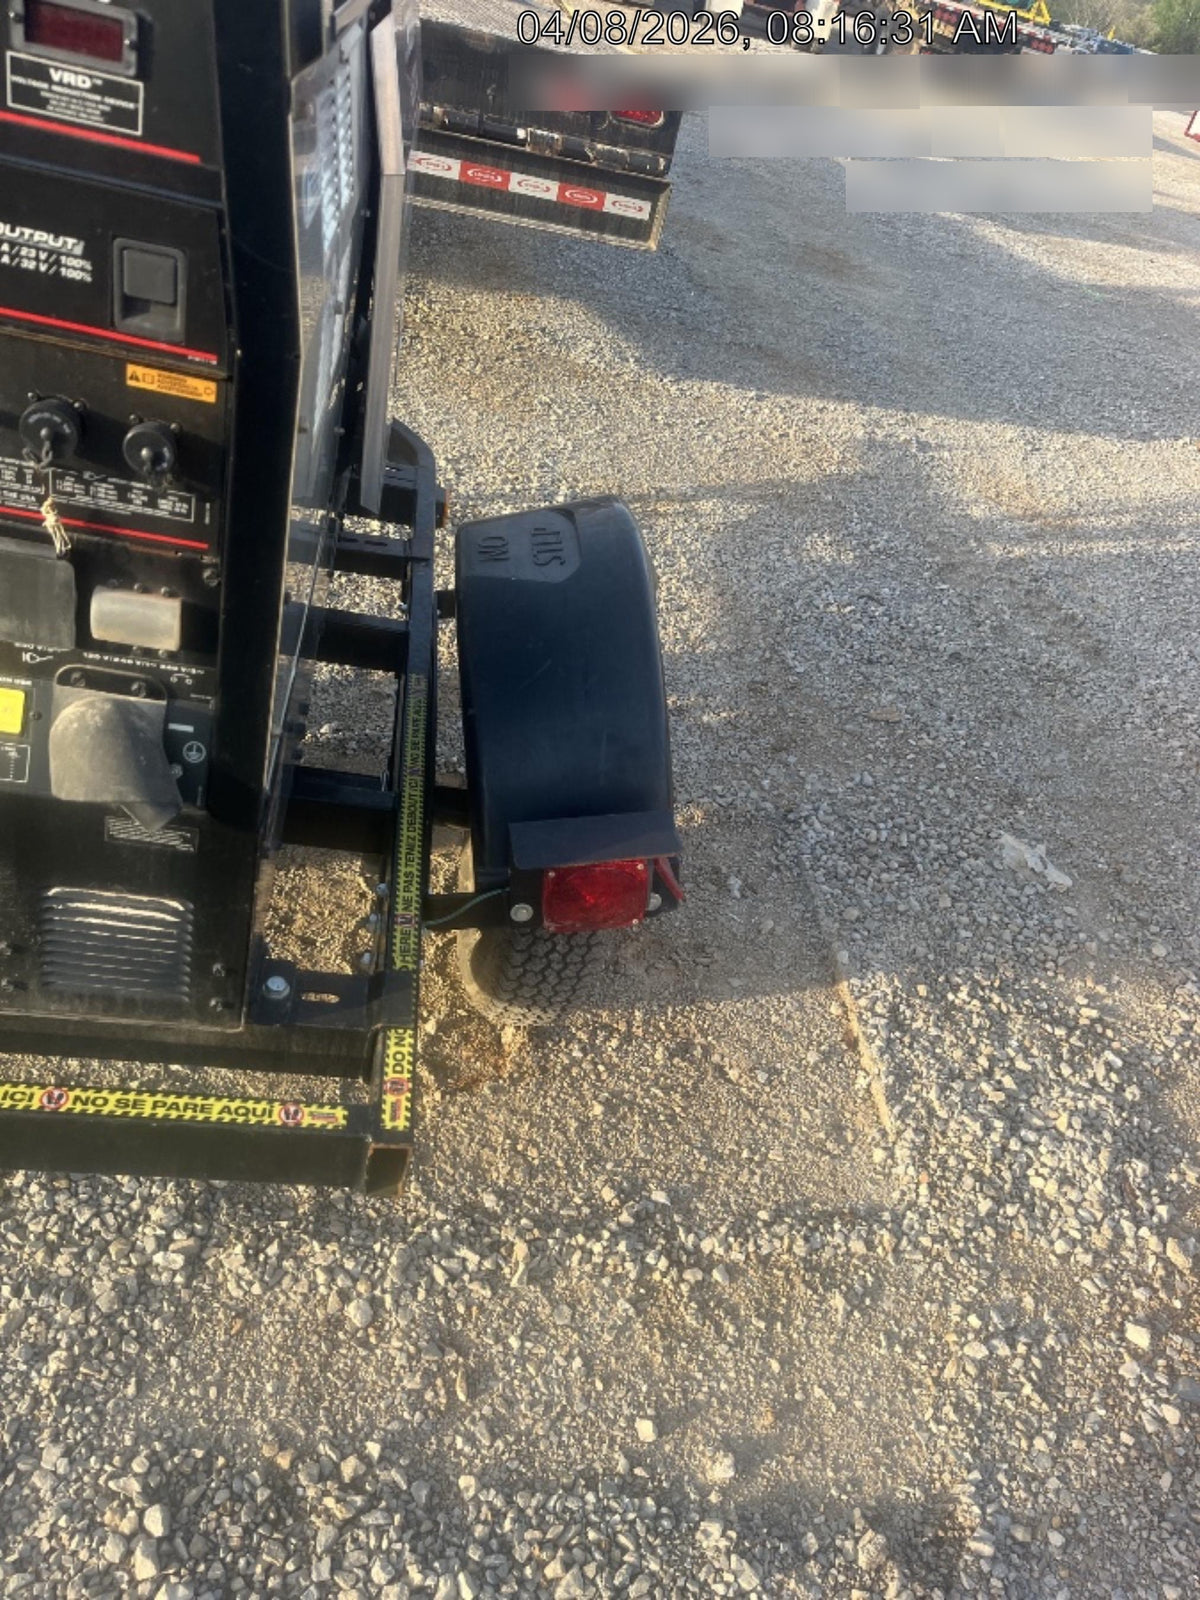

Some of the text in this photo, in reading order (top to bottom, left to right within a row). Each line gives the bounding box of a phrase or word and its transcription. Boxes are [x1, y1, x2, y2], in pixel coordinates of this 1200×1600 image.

[478, 536, 510, 562] NO
[403, 869, 415, 894] PAS
[402, 895, 413, 913] NE
[401, 927, 412, 963] HERE
[392, 1050, 406, 1075] DO
[1, 1090, 35, 1103] ICI
[73, 1095, 109, 1107] NO
[114, 1098, 146, 1111] SE
[152, 1100, 213, 1115] PARE
